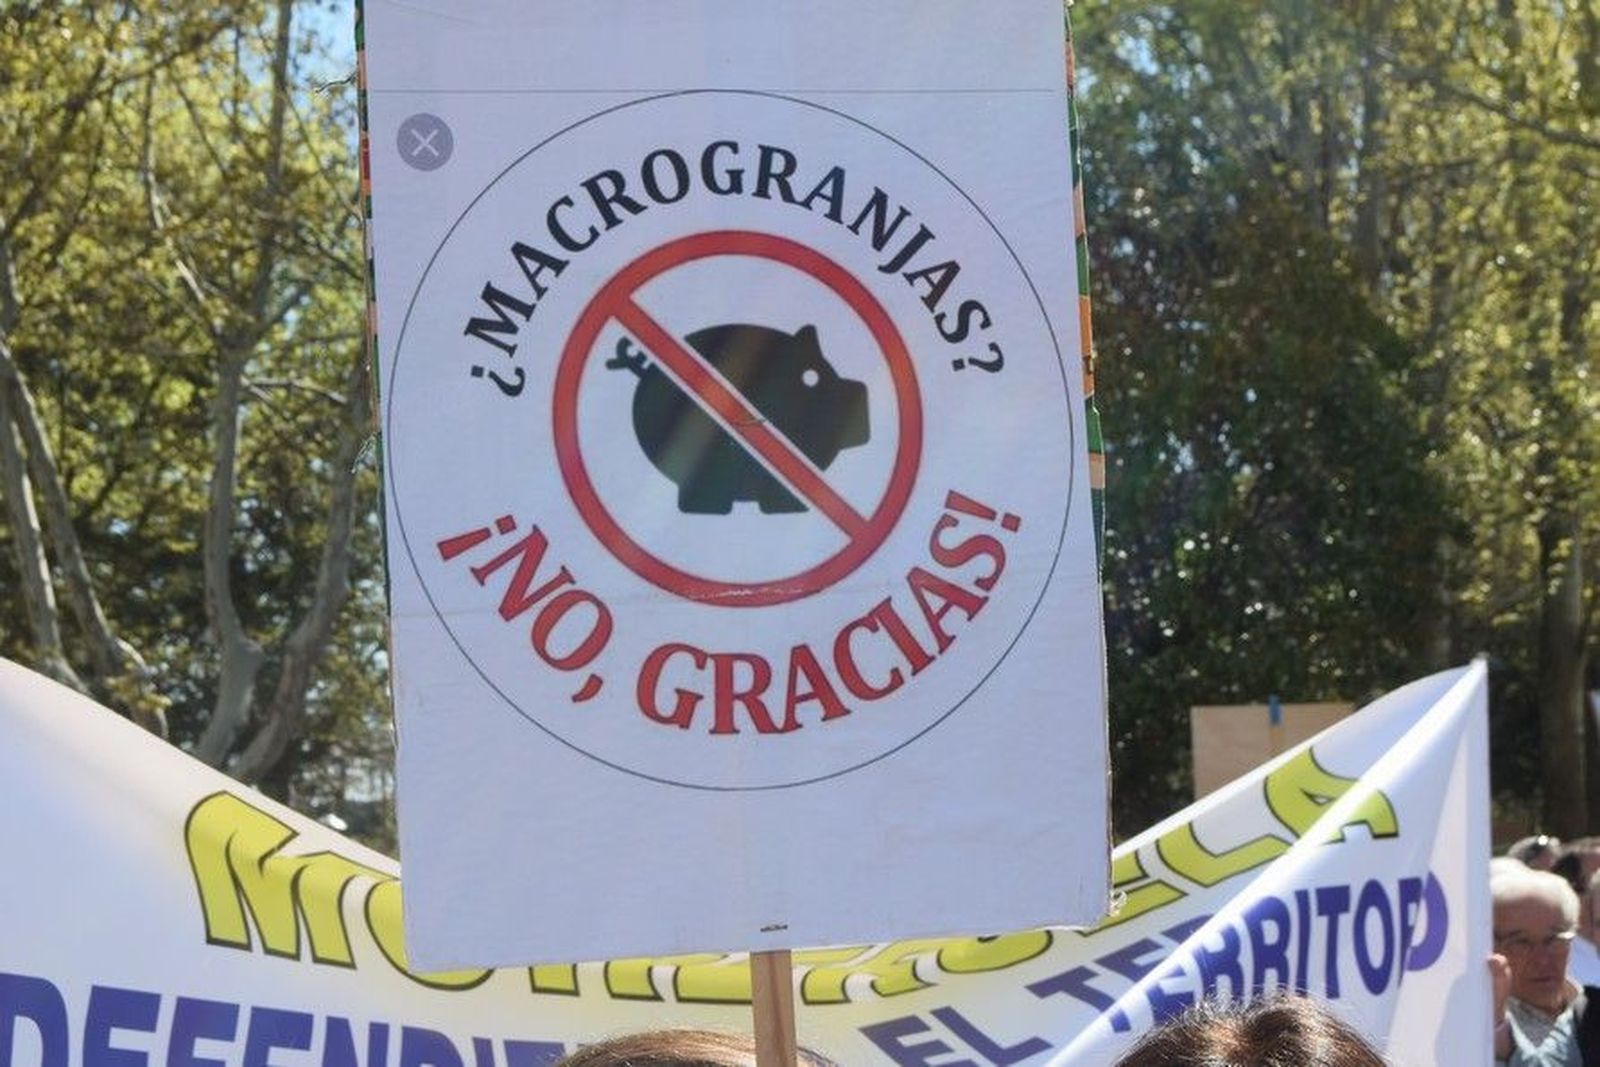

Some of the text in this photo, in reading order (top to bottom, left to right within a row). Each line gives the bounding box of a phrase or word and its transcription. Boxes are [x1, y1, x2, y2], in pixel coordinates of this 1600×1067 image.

[464, 140, 1005, 397] ¿MACROGRANJAS?
[437, 490, 1022, 735] ¡NO, GRACIAS!
